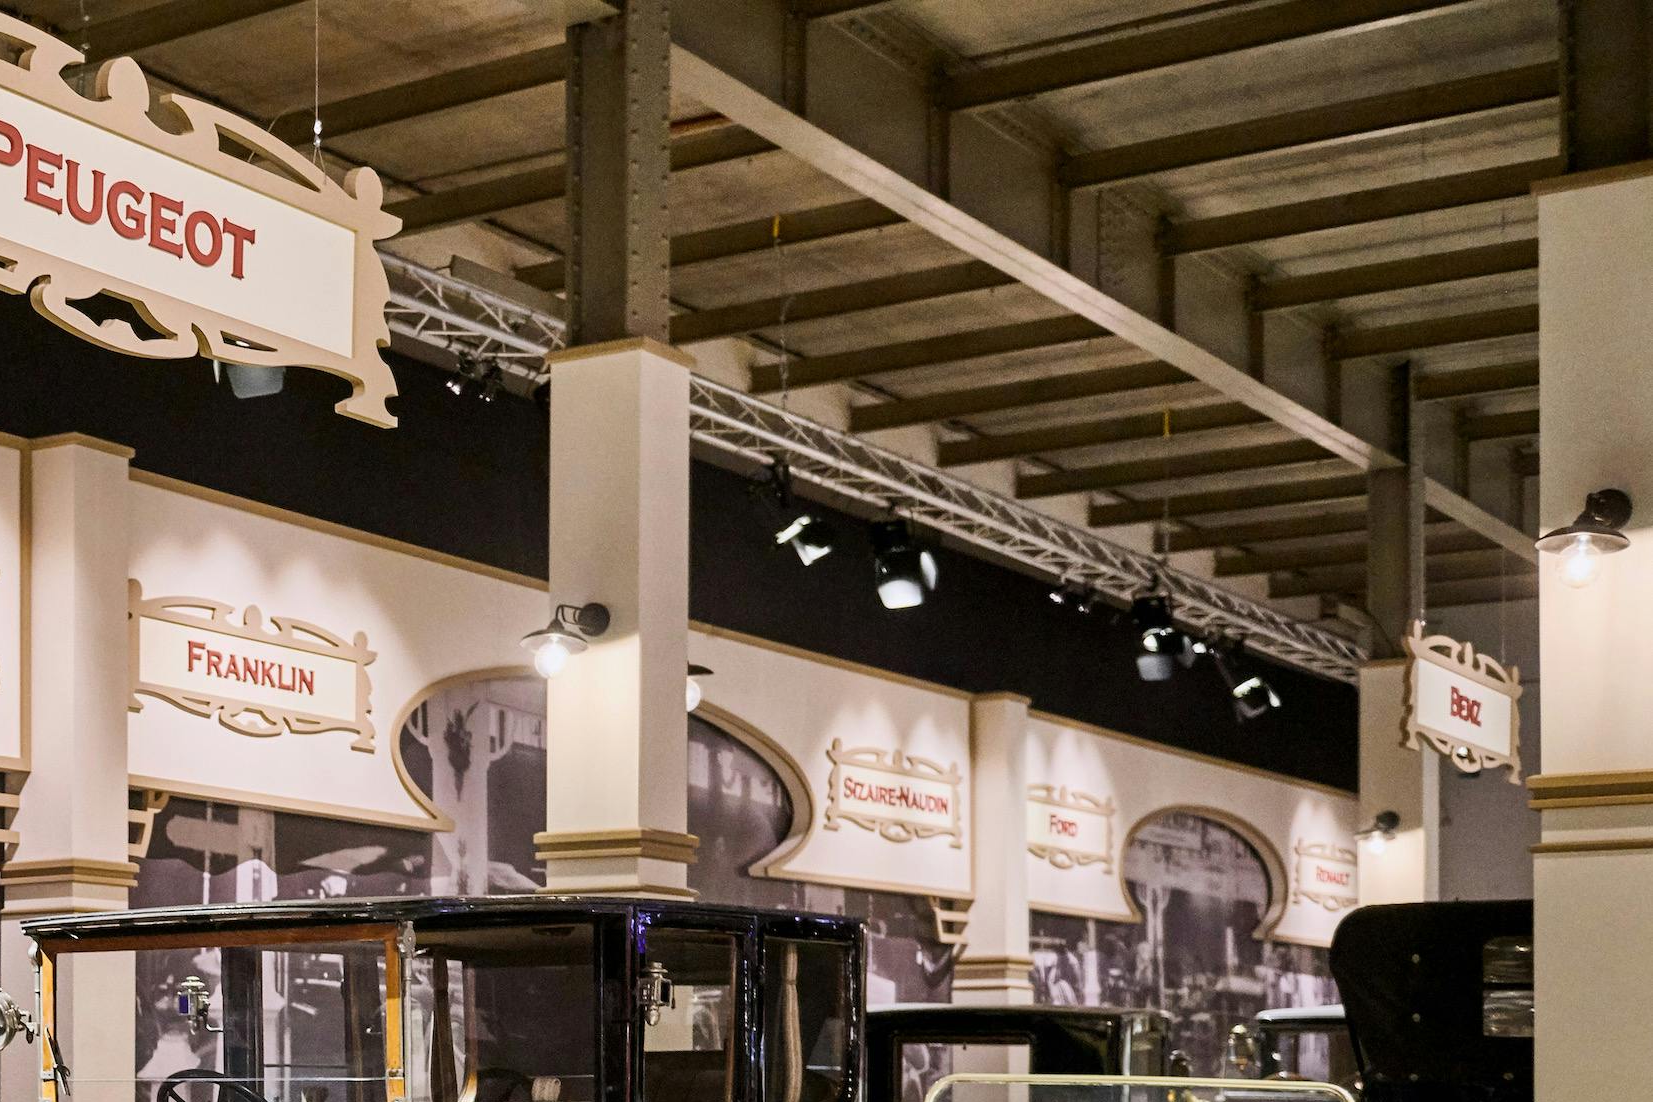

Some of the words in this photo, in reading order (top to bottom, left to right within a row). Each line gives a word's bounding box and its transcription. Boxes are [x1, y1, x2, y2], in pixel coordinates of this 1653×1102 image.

[188, 640, 315, 696] FRANKLIN
[1450, 685, 1482, 728] BENZ
[843, 776, 949, 814] SIZAIRE-NAUDIN
[1049, 813, 1077, 838] FORD
